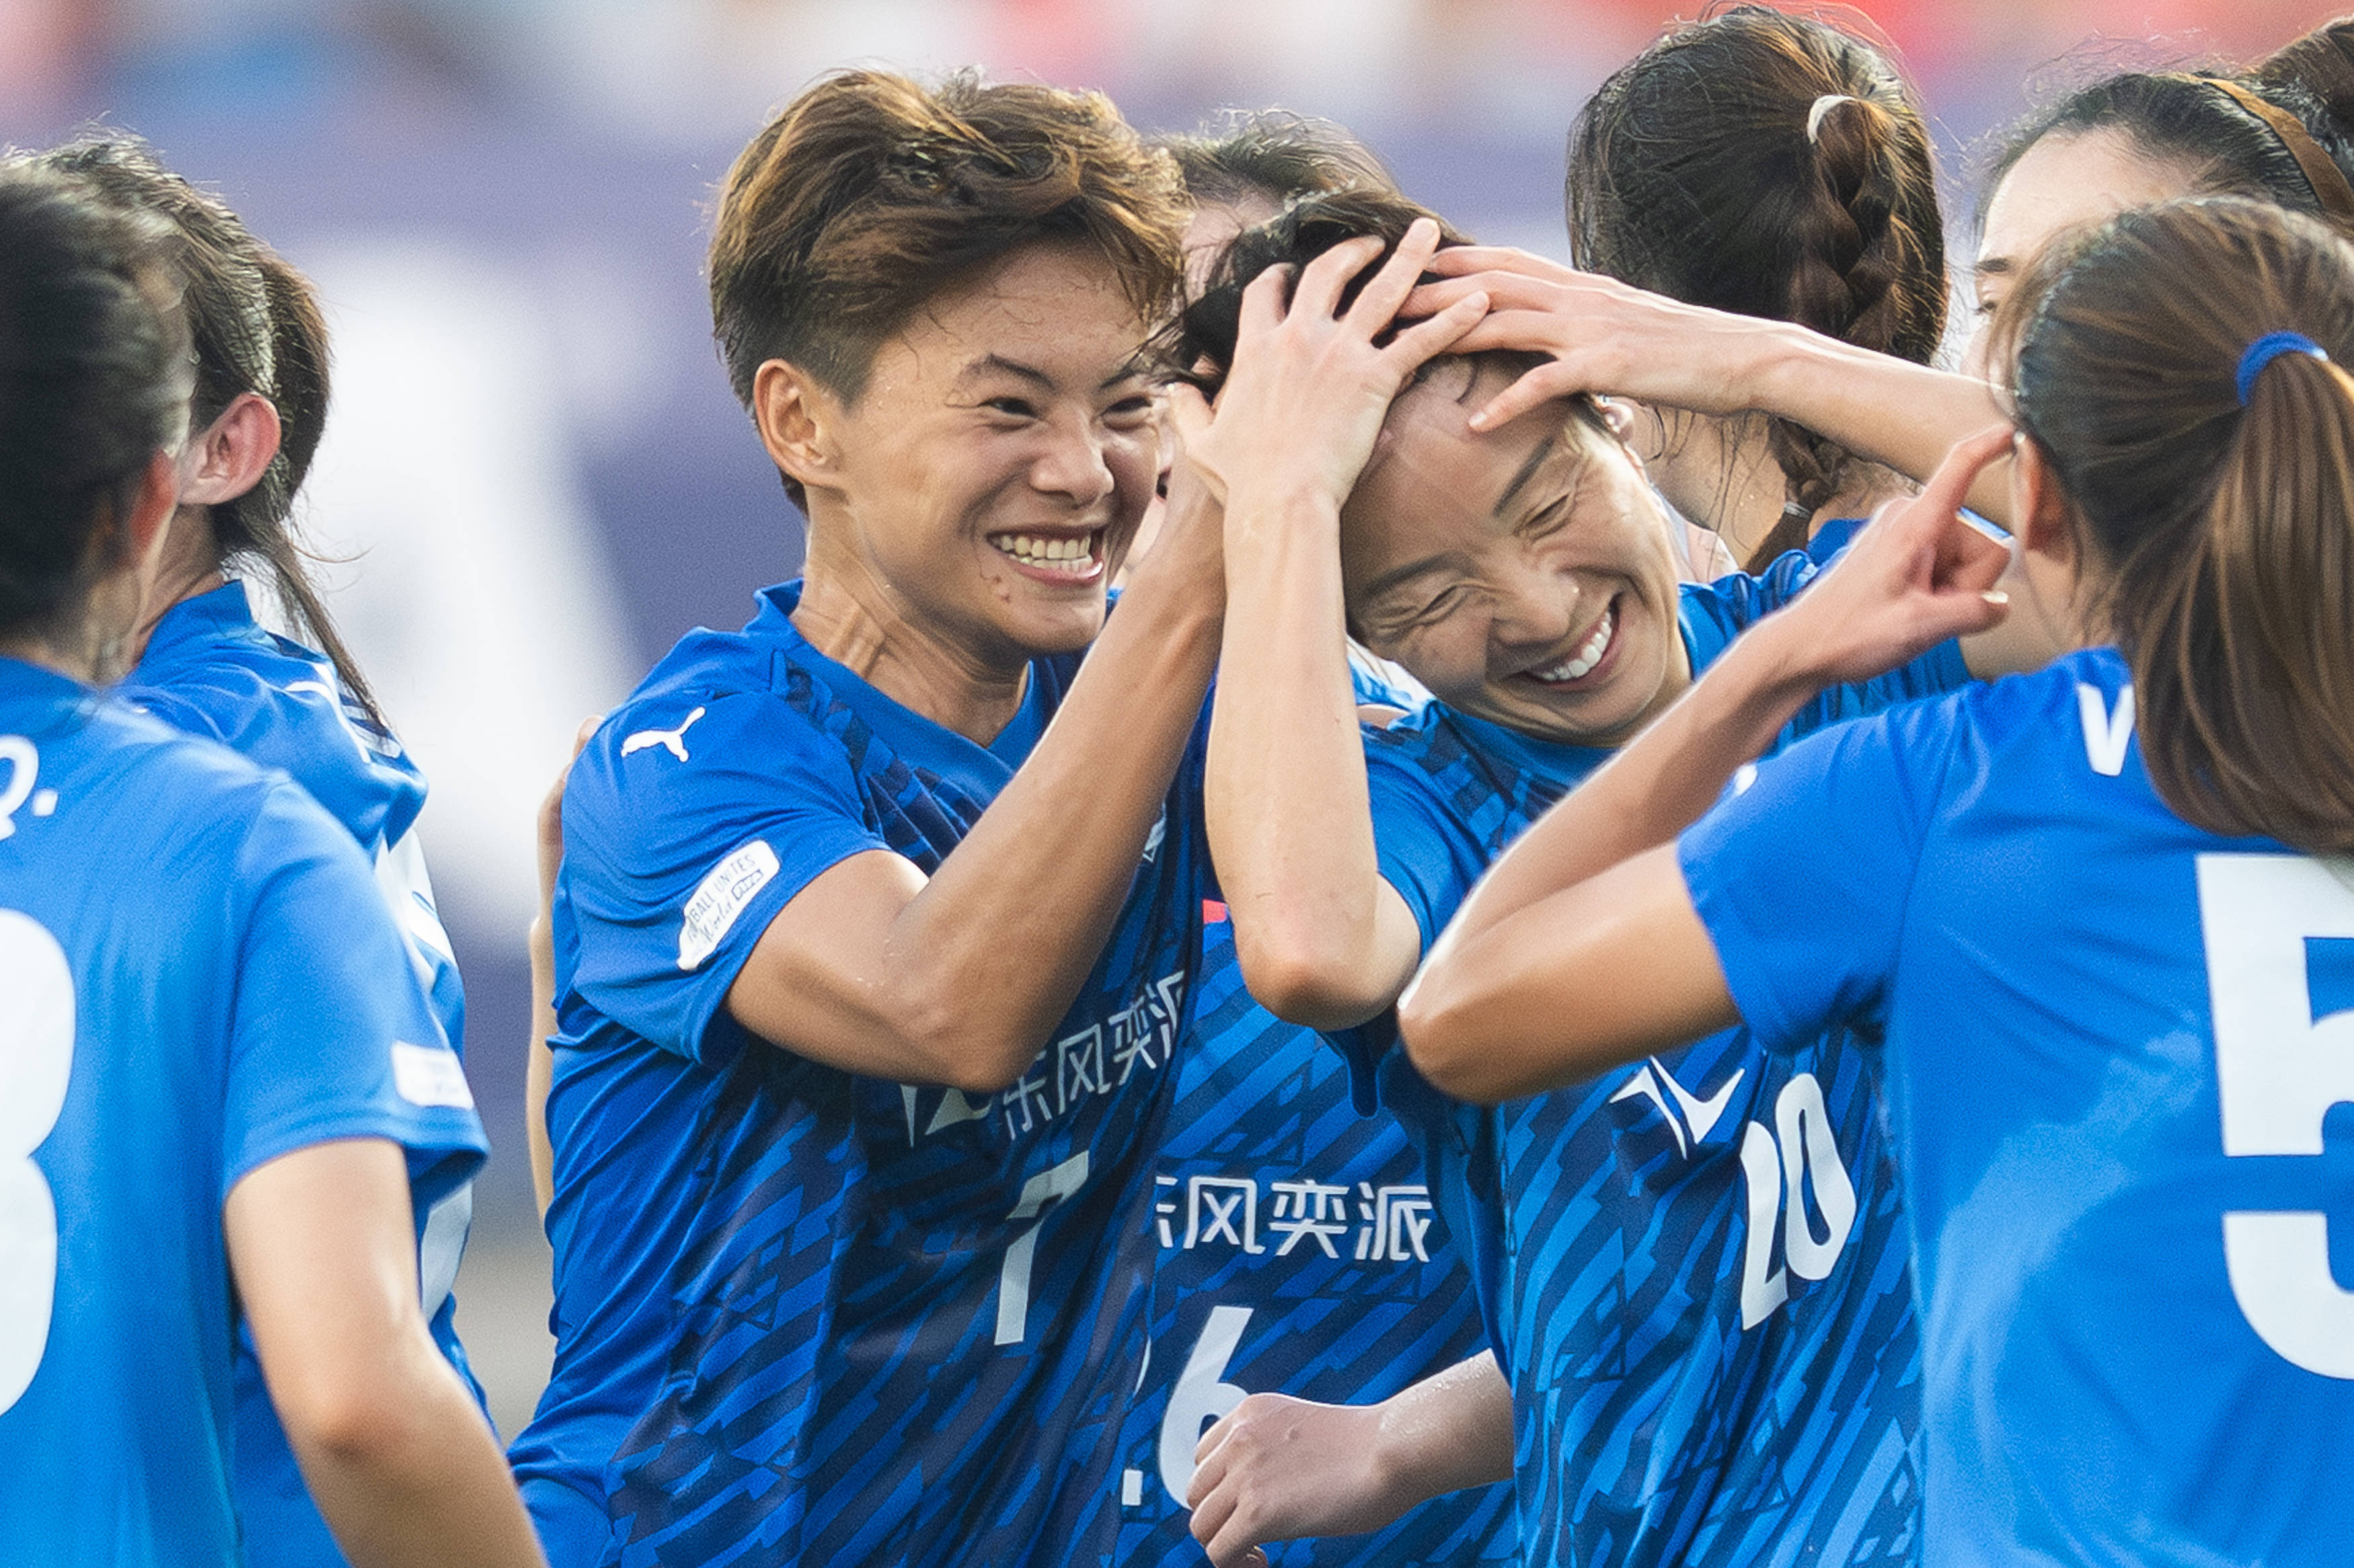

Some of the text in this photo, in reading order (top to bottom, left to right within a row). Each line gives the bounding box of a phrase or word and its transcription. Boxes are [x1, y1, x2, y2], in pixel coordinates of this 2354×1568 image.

[994, 1150, 1090, 1345] 7
[1739, 1072, 1857, 1331] 20
[1122, 1306, 1255, 1510] 6
